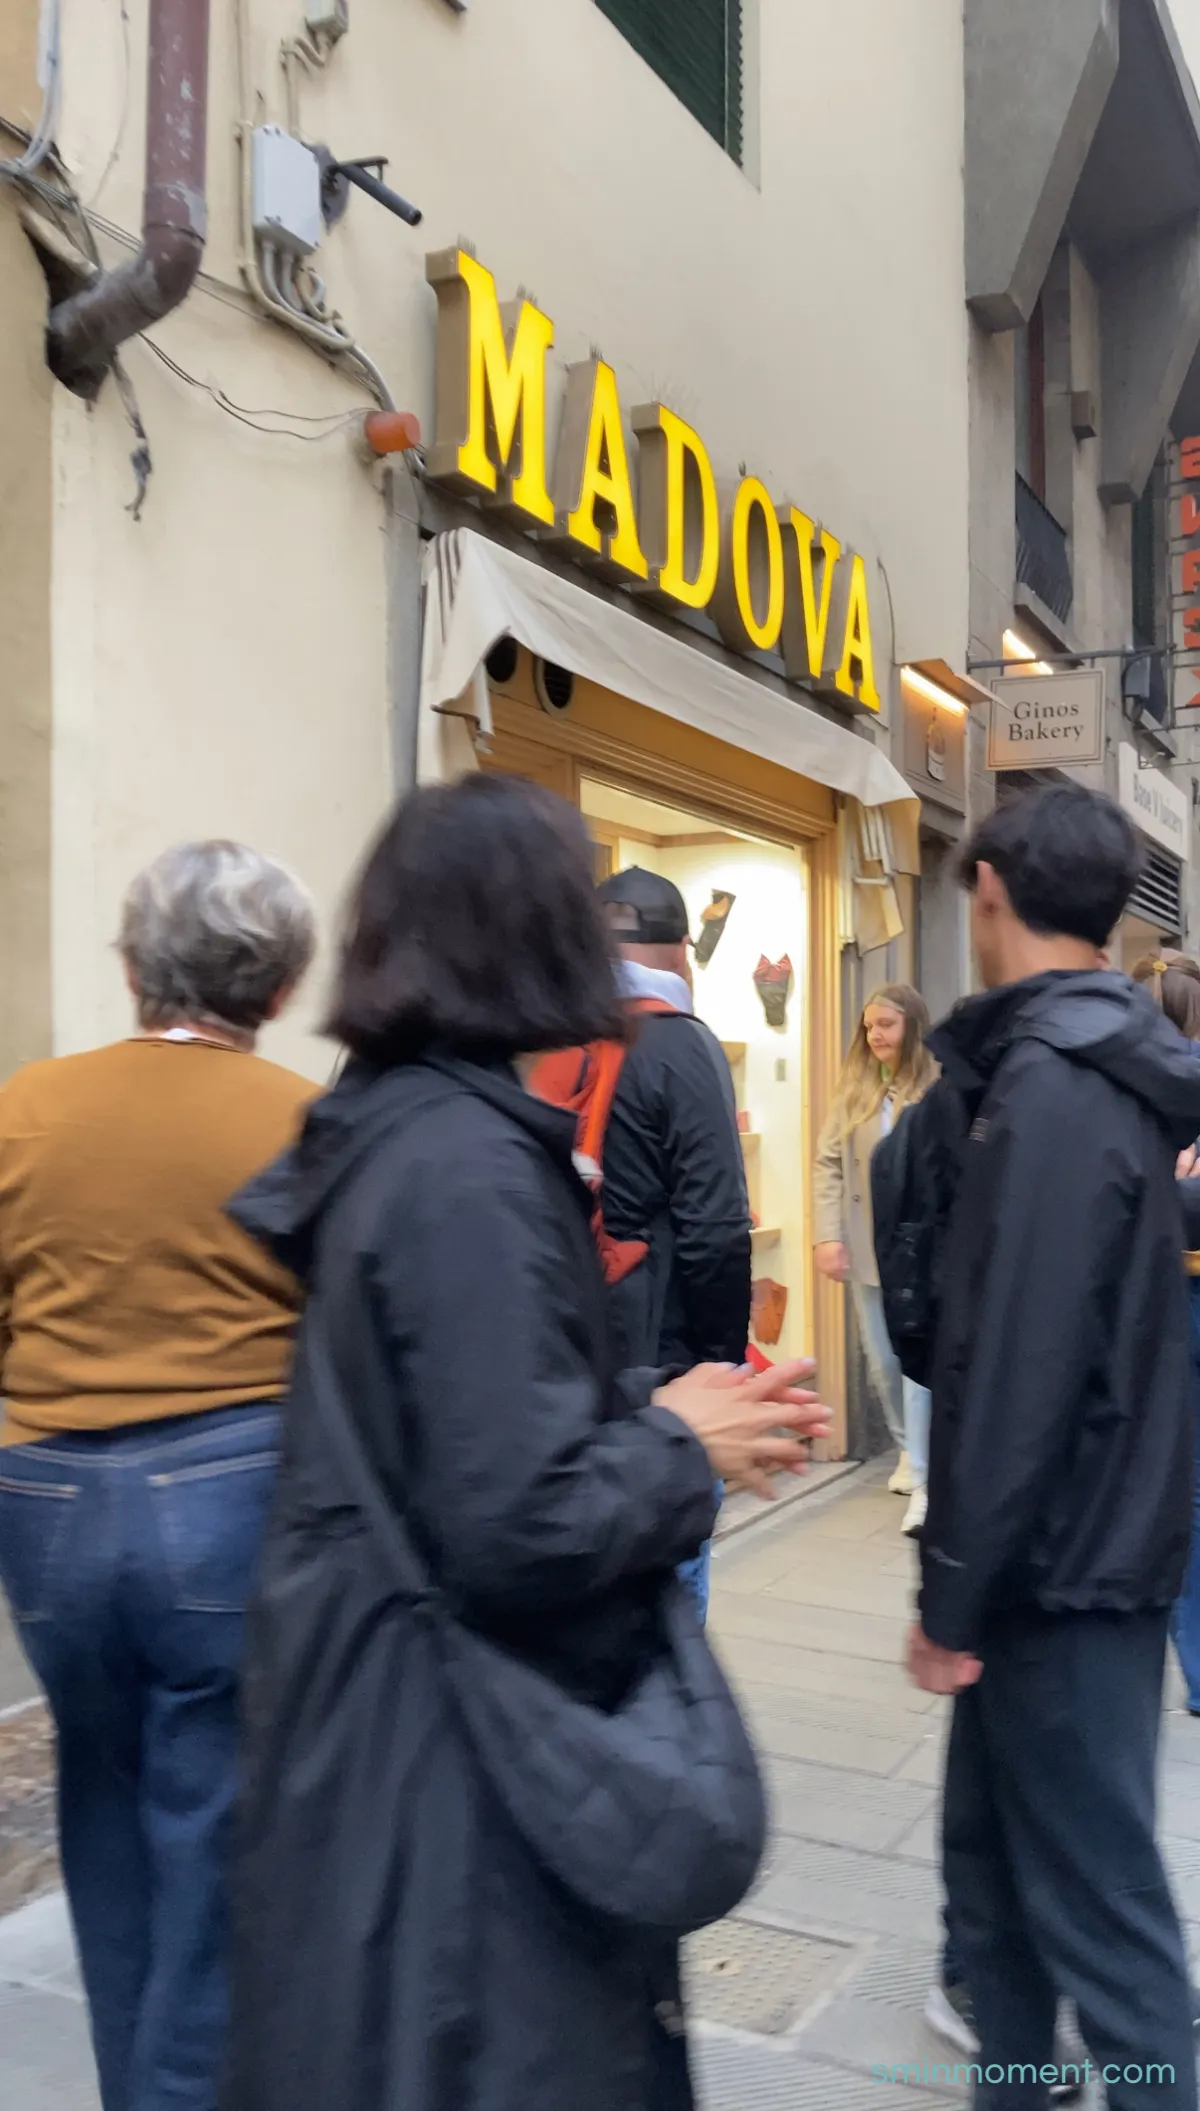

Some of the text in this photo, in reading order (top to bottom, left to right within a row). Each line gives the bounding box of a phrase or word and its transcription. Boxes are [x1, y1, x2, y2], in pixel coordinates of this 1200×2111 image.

[457, 248, 881, 714] MADOVA
[1013, 701, 1080, 720] Ginos
[1008, 721, 1084, 743] Bakery
